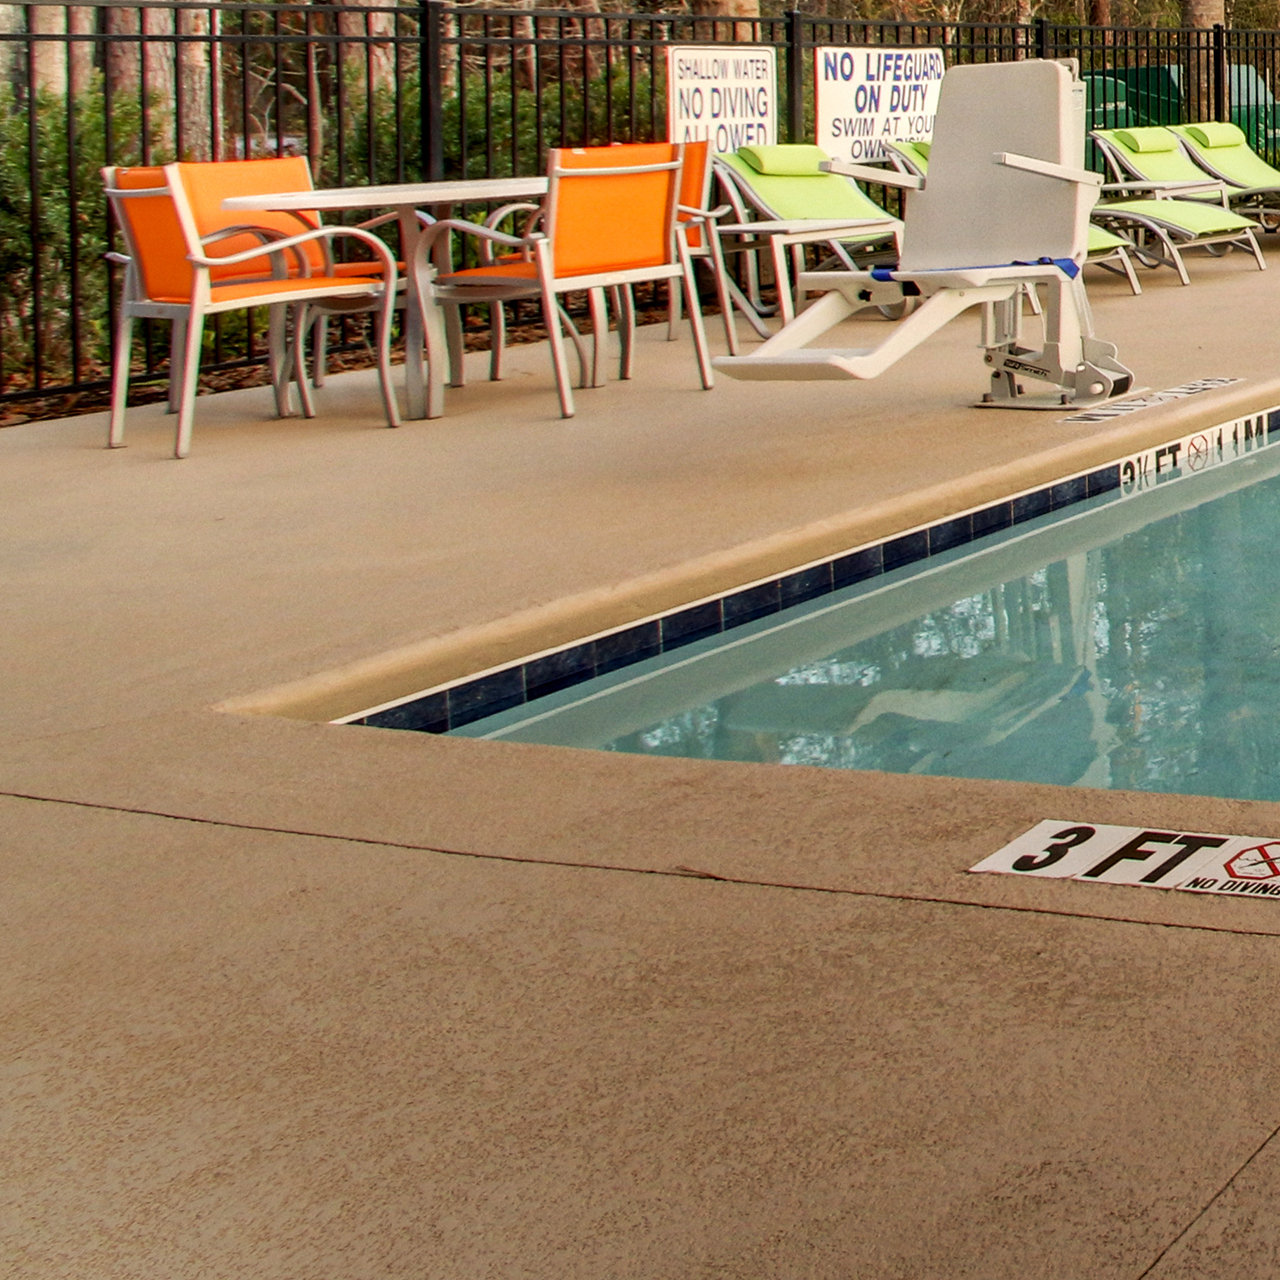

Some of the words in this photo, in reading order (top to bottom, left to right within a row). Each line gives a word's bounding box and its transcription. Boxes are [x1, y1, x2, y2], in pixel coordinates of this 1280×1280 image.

[678, 59, 729, 79] SHALLOW
[733, 59, 768, 79] WATER
[824, 52, 854, 81] NO
[866, 52, 944, 81] LIFEGUARD
[679, 87, 701, 119] NO
[711, 87, 768, 118] DIVING
[855, 85, 880, 113] ON
[890, 84, 928, 113] DUTY
[832, 117, 874, 137] SWIM
[882, 117, 900, 135] AT
[908, 115, 936, 134] YOU
[851, 140, 887, 159] OWN
[1012, 826, 1096, 873] 3
[1082, 831, 1230, 884] FT
[1185, 876, 1219, 889] NO
